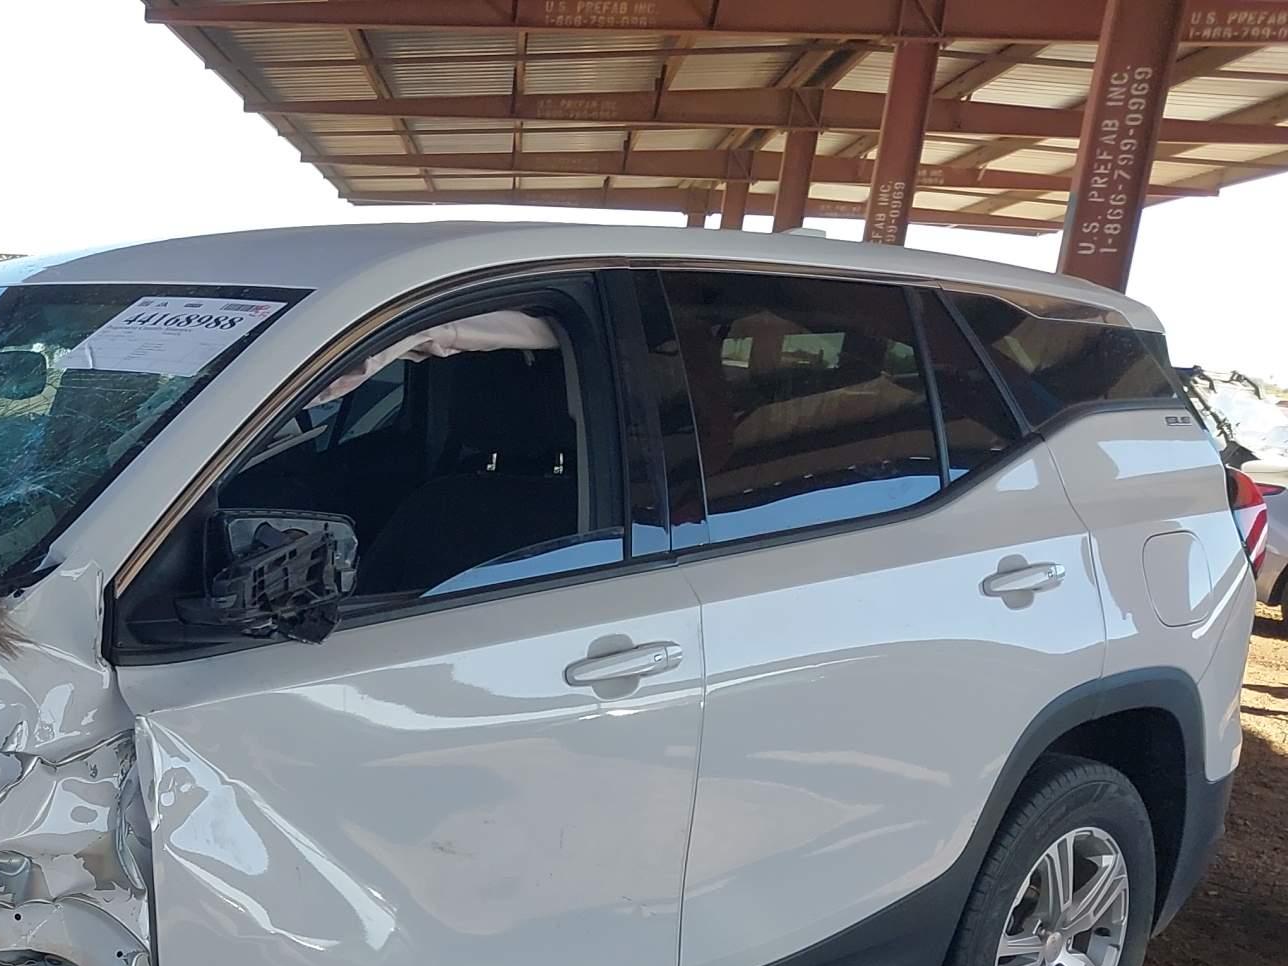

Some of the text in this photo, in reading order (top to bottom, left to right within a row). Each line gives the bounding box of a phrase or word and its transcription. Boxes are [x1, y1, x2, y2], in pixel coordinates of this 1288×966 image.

[576, 0, 628, 14] PREFAB
[1077, 65, 1131, 255] U.S. PREFAB INC.
[1099, 67, 1153, 253] 1-866-799-0969
[123, 311, 244, 331] 44168988
